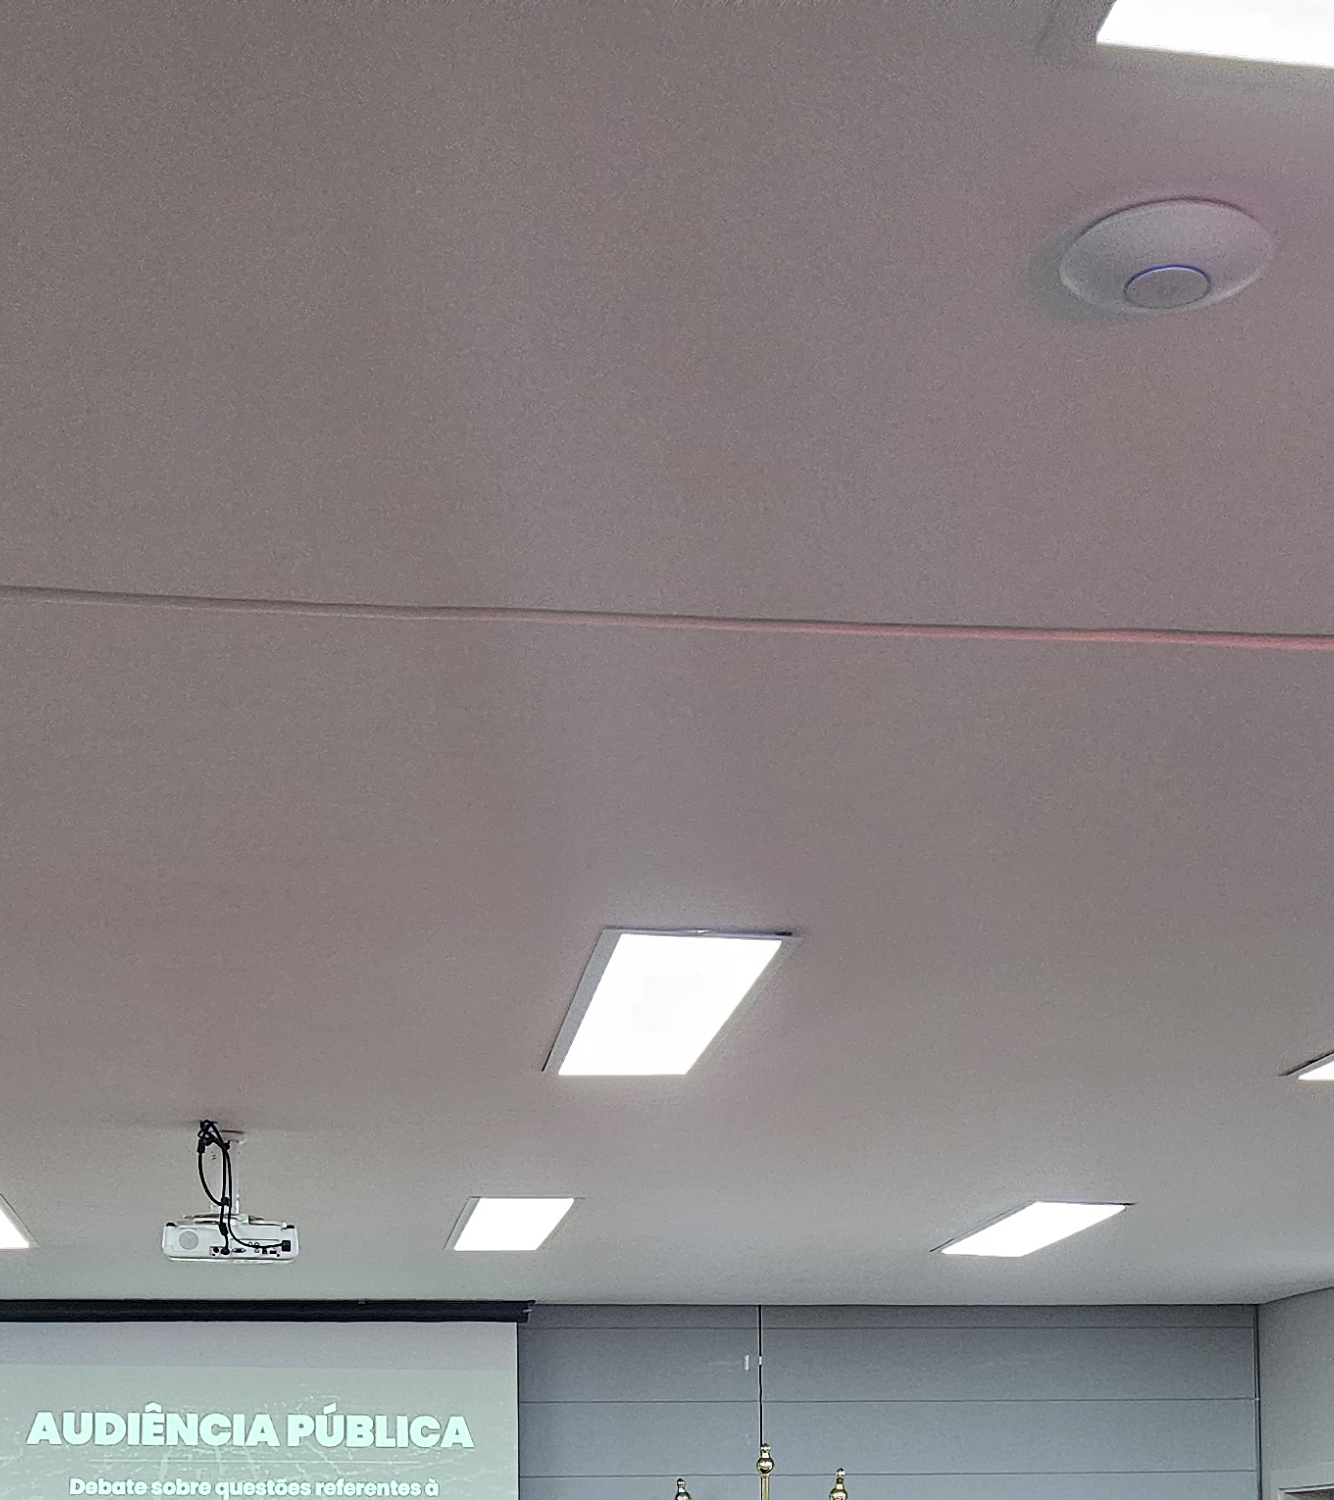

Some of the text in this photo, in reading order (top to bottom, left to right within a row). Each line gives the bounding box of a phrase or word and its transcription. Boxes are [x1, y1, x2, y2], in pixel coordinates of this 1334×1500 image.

[26, 1402, 474, 1448] AUDIÊNCIA PÚBLICA
[70, 1478, 440, 1500] Debate sobre questões referentes à
